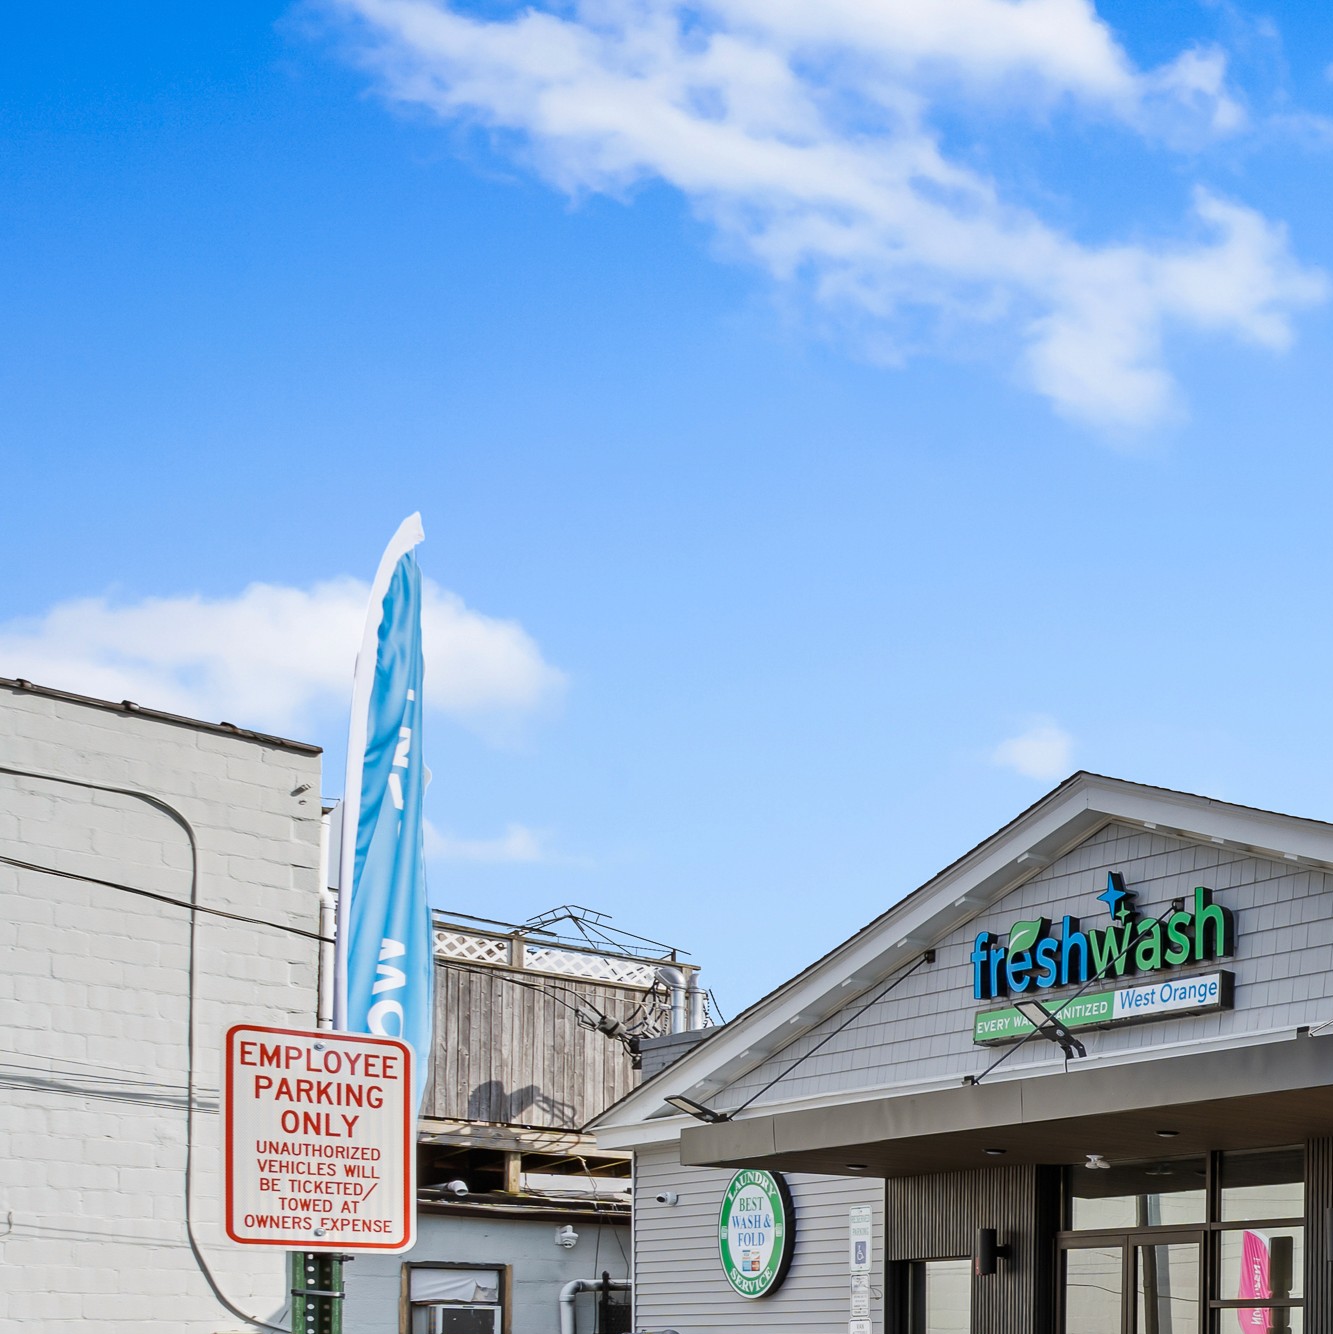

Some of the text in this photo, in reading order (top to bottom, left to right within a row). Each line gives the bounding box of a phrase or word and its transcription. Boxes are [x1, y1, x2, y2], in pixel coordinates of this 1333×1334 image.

[970, 886, 1226, 1000] freshwash
[366, 937, 407, 1039] OW
[1120, 981, 1218, 1010] West Orange
[977, 1018, 1010, 1034] EVERY
[240, 1040, 398, 1080] EMPLOYEE
[254, 1074, 384, 1109] PARKING
[281, 1109, 360, 1138] ONLY
[256, 1140, 381, 1161] UNAUTHORIZED
[257, 1159, 380, 1179] VEHICLES WILL
[259, 1178, 378, 1201] BE TICKETED/
[726, 1171, 777, 1202] LAUNDRY
[278, 1197, 360, 1214] TOWED AT
[739, 1197, 764, 1212] BEST
[244, 1214, 393, 1233] OWNERS EXPENSE
[731, 1213, 772, 1229] WASH &
[738, 1232, 765, 1247] FOLD
[729, 1266, 773, 1293] SERVICE
